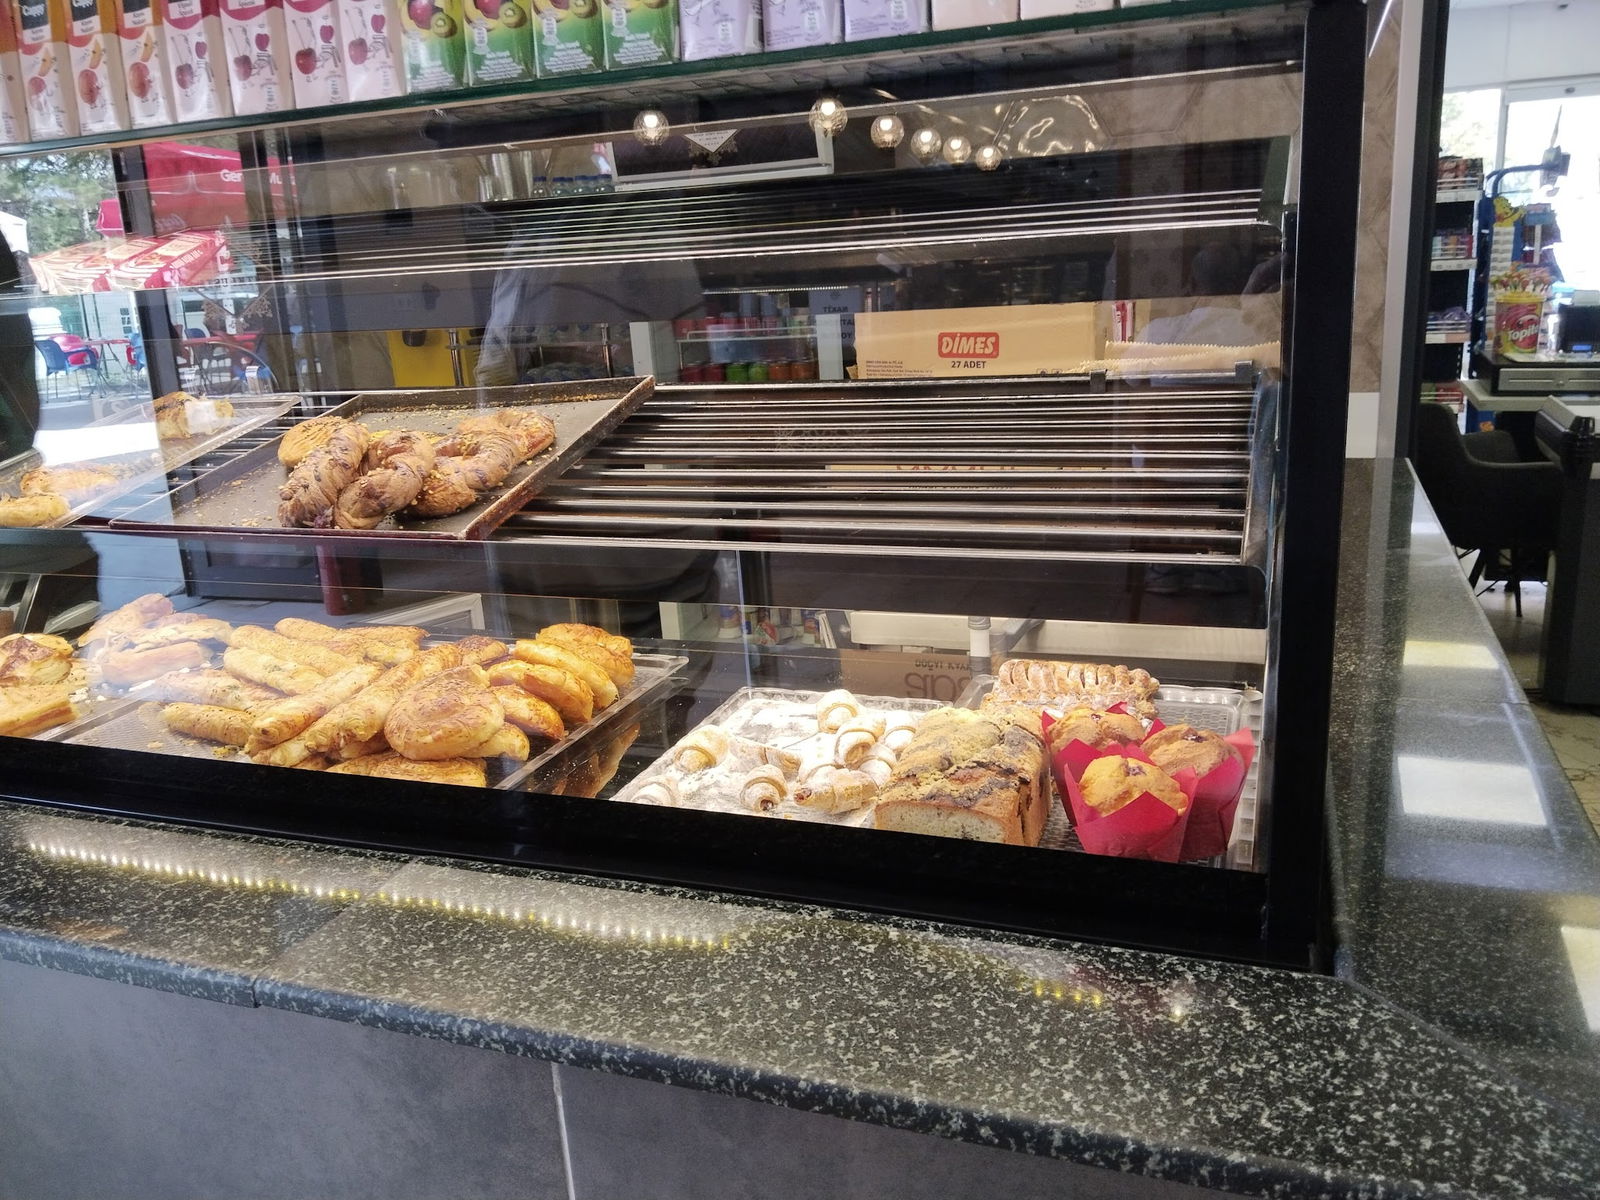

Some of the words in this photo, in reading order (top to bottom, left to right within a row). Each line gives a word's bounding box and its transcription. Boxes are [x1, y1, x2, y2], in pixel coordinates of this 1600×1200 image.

[942, 333, 995, 354] DİMES
[951, 361, 961, 369] 27
[963, 361, 987, 369] ADET
